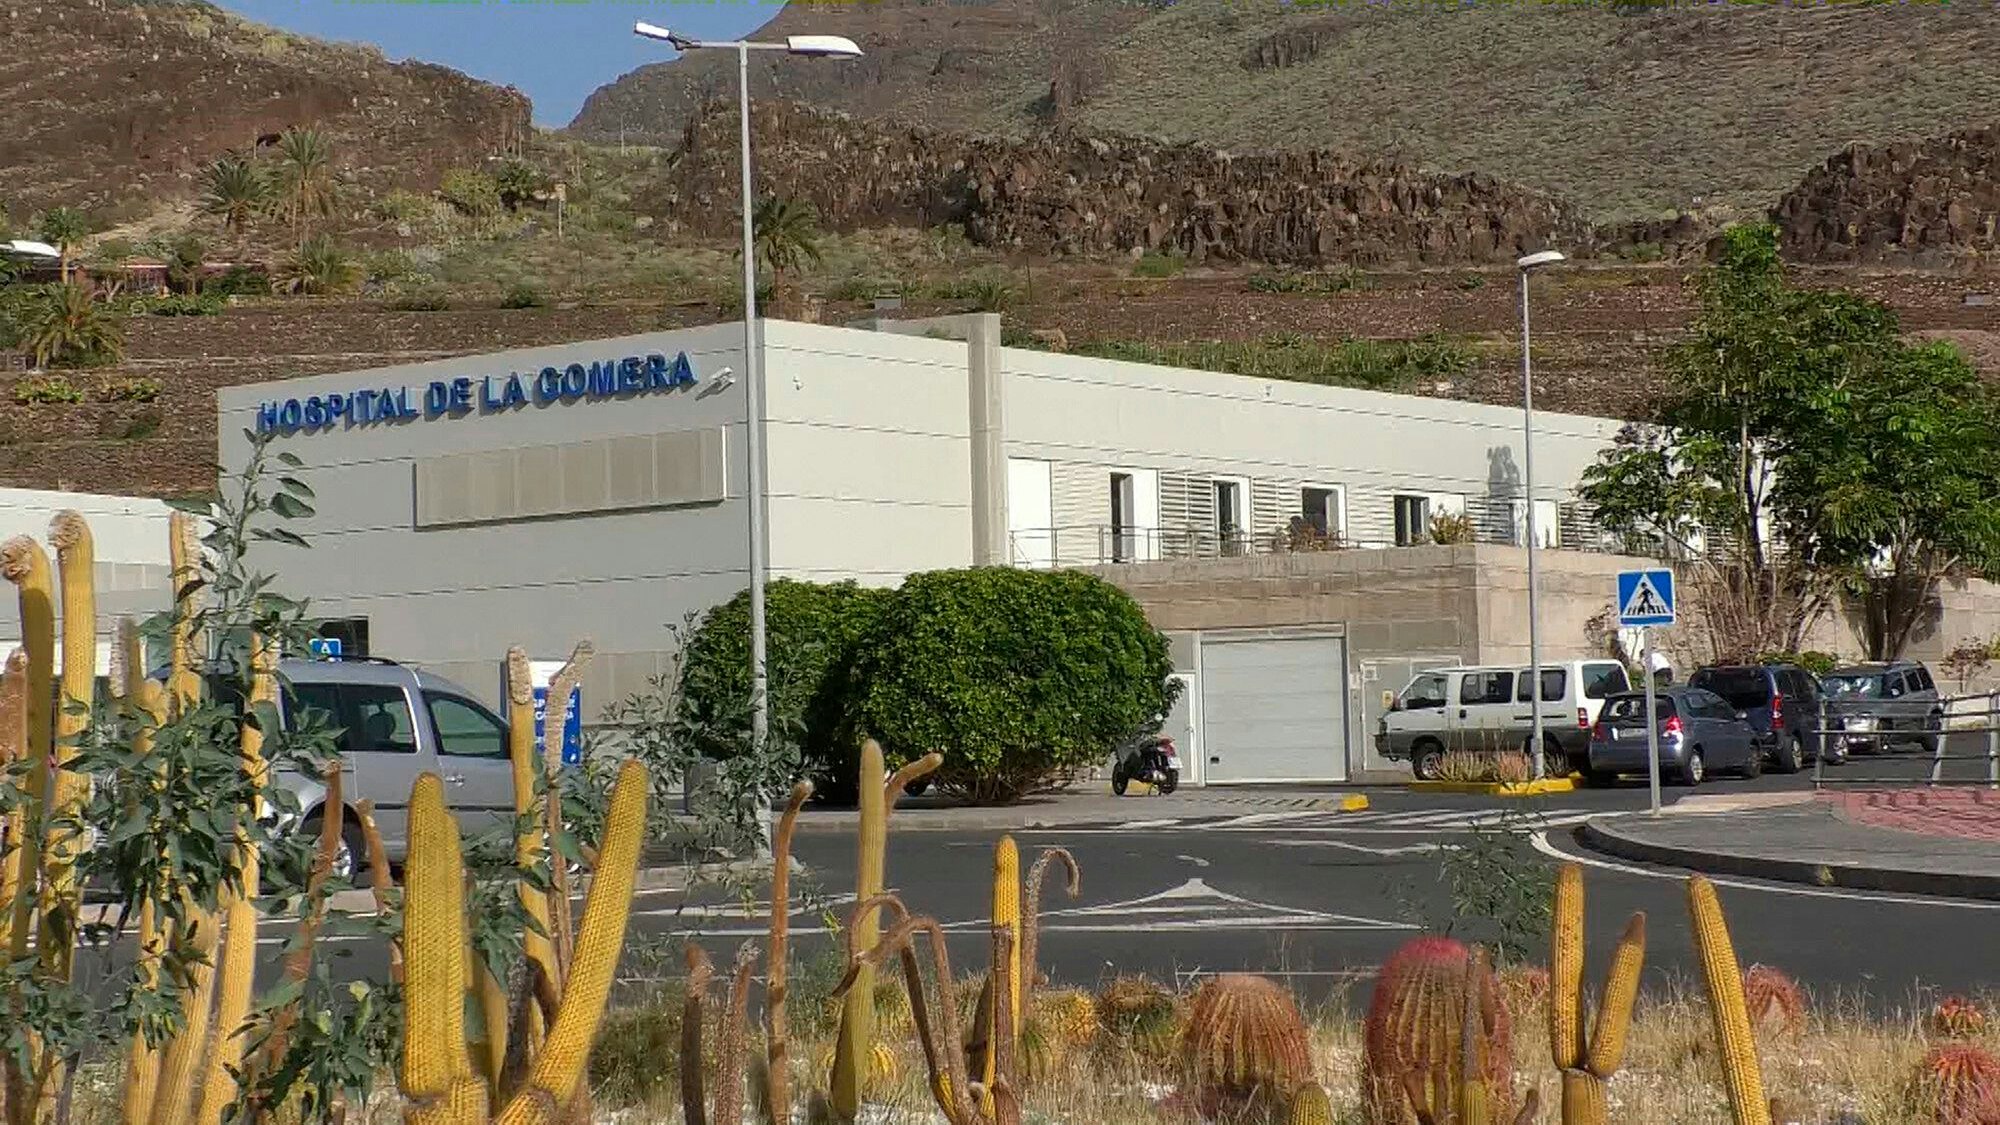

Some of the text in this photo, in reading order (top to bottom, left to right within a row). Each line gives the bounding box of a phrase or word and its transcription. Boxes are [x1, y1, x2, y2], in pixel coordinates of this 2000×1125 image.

[257, 351, 697, 434] HOSPITAL DE LA GOMERA
